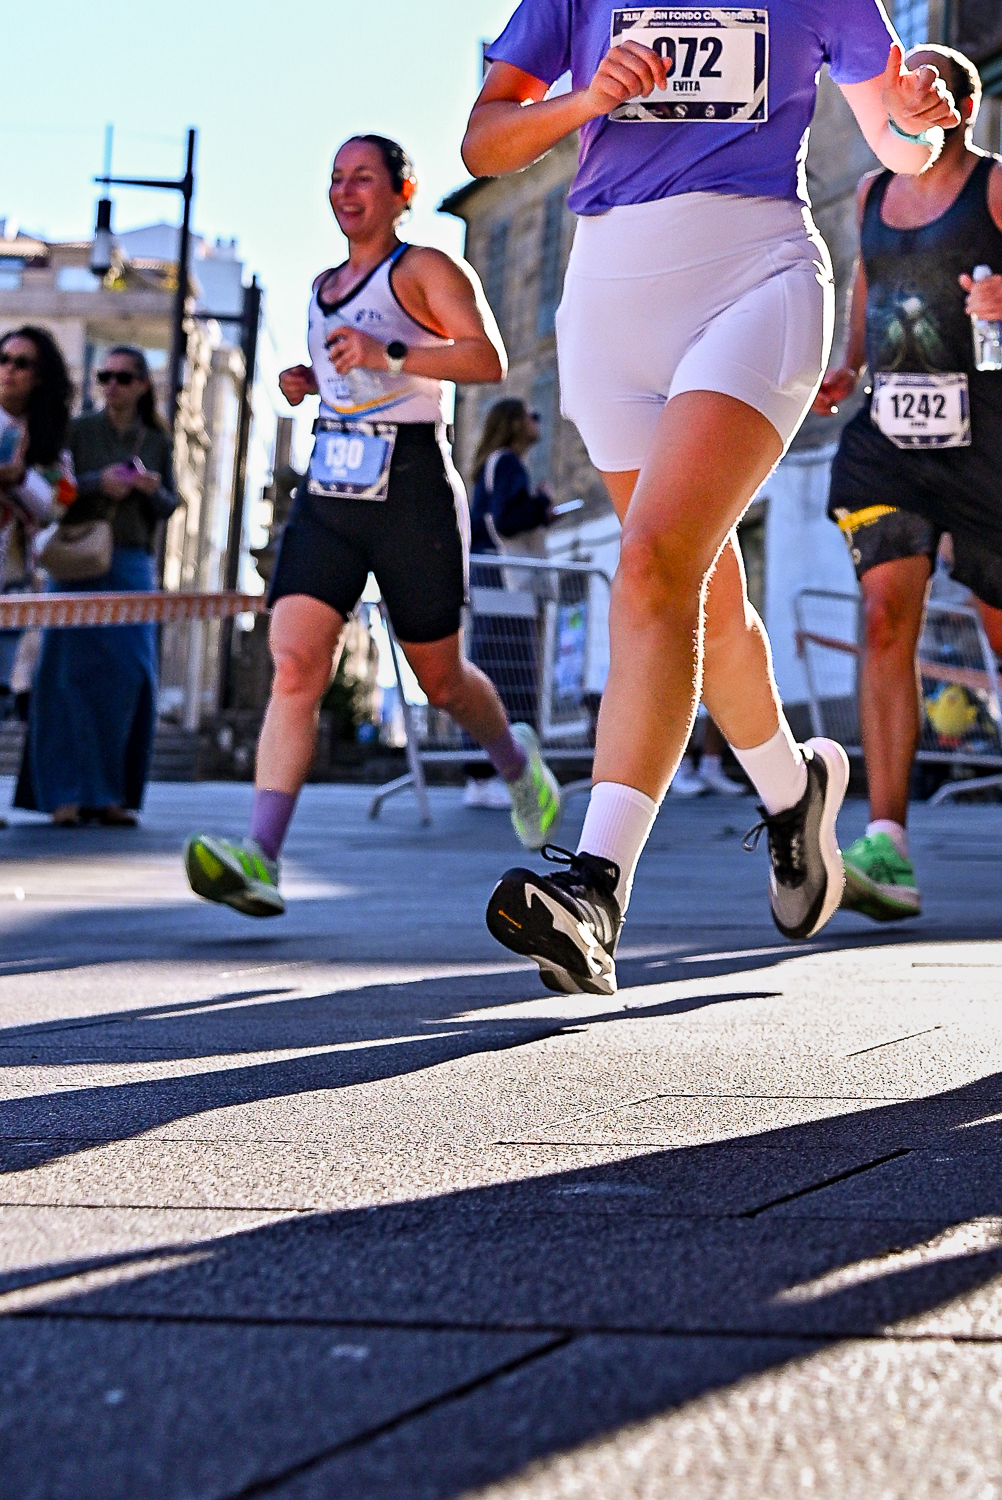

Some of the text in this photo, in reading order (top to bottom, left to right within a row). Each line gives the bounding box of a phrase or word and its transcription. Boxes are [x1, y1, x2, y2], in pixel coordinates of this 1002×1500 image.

[669, 11, 701, 21] FONDO
[703, 11, 756, 21] CAABANK
[673, 80, 701, 91] EVITA
[890, 393, 947, 419] 1242
[324, 436, 365, 471] 130
